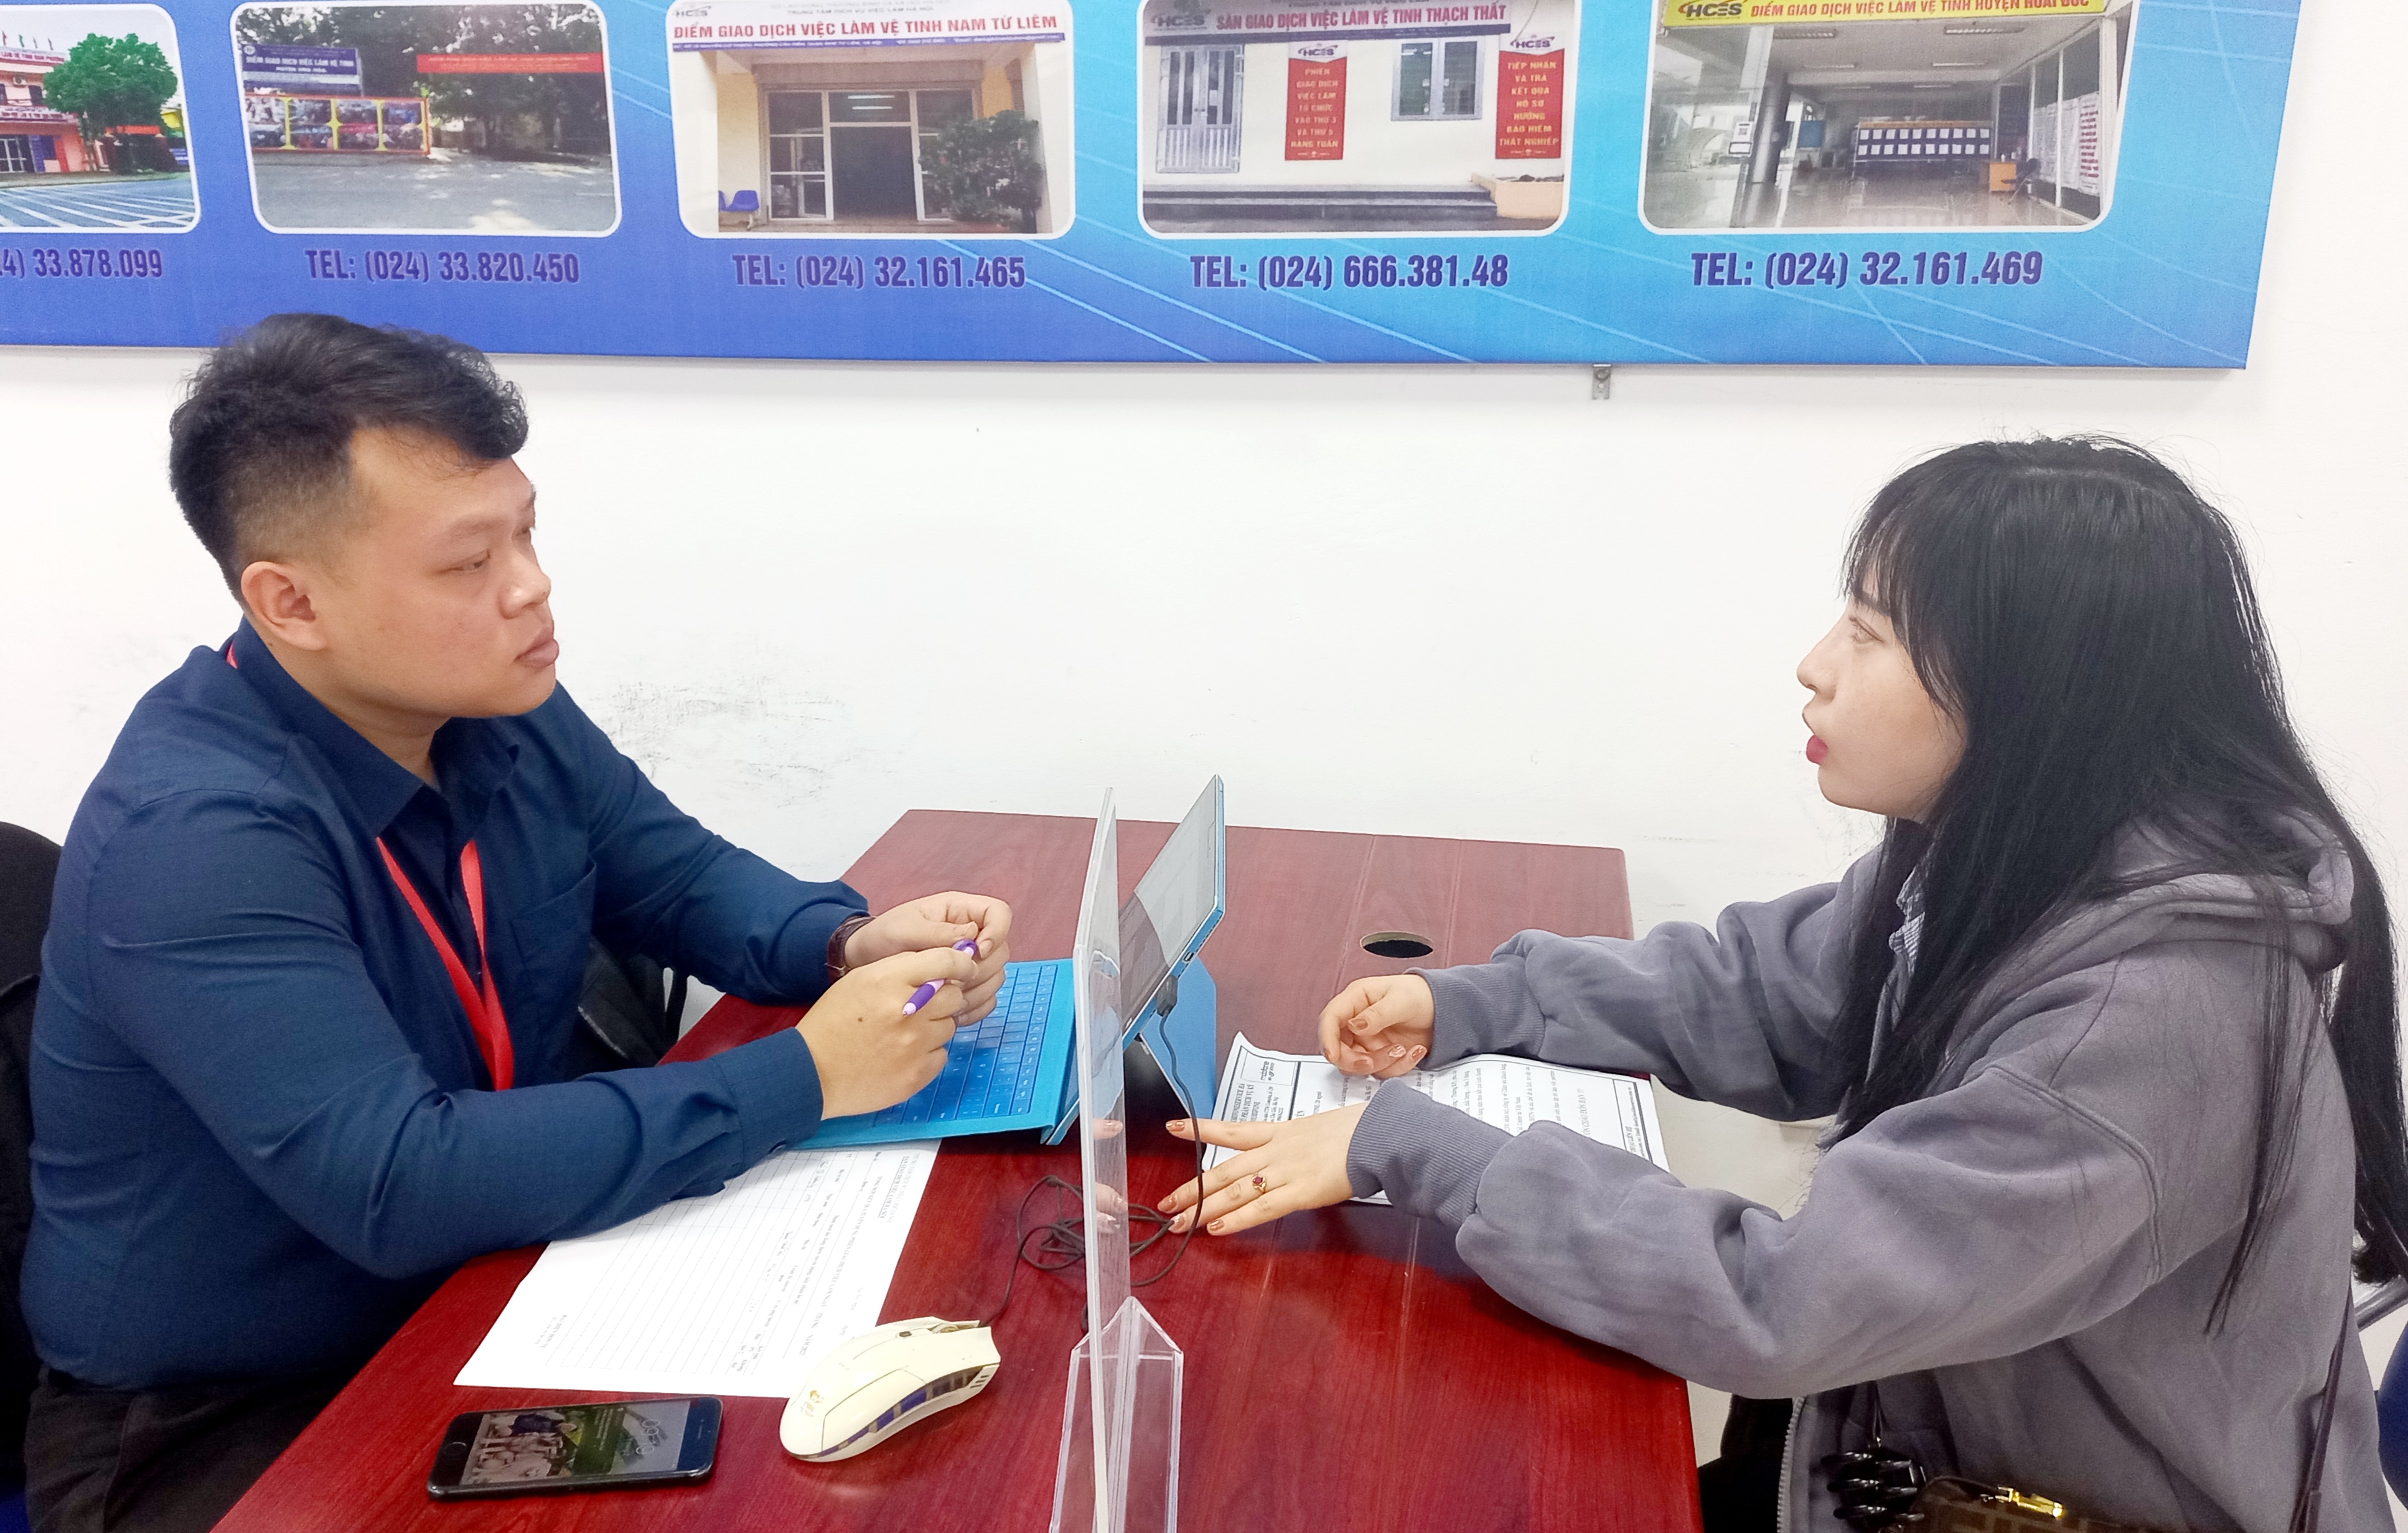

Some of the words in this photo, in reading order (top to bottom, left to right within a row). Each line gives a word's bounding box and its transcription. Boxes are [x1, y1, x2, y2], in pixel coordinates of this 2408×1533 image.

[1245, 14, 1274, 29] GIAO
[1277, 12, 1307, 31] DỊCH
[1310, 9, 1338, 29] VIỆC
[1342, 8, 1369, 26] LÀM
[1394, 9, 1422, 24] TINH
[1787, 4, 1816, 16] GIAO
[1821, 2, 1852, 18] DỊCH
[1856, 1, 1884, 17] VIỆC
[1941, 1, 1970, 11] TINH
[673, 22, 713, 39] ĐIỂM
[718, 25, 754, 37] GIAO
[759, 24, 796, 39] DỊCH
[800, 21, 836, 38] VIỆC
[841, 20, 875, 35] LÀM
[881, 19, 899, 36] VỆ
[905, 21, 942, 33] TINH
[947, 18, 986, 32] NAM
[991, 15, 1012, 30] TỪ
[1017, 14, 1057, 29] LIÊM
[33, 248, 163, 278] 33.878.099
[305, 250, 356, 279] TEL:
[365, 250, 429, 283] (024)
[438, 251, 580, 283] 33.820.450
[732, 255, 785, 286] TEL:
[796, 255, 864, 289] (024)
[874, 256, 1025, 288] 32.161.465
[1190, 255, 1247, 288] TEL:
[1258, 255, 1333, 291] (024)
[1343, 254, 1509, 288] 666.381.48
[1691, 252, 1752, 286] TEL:
[1765, 251, 1848, 289] (024)
[1859, 250, 2043, 285] 32.161.469
